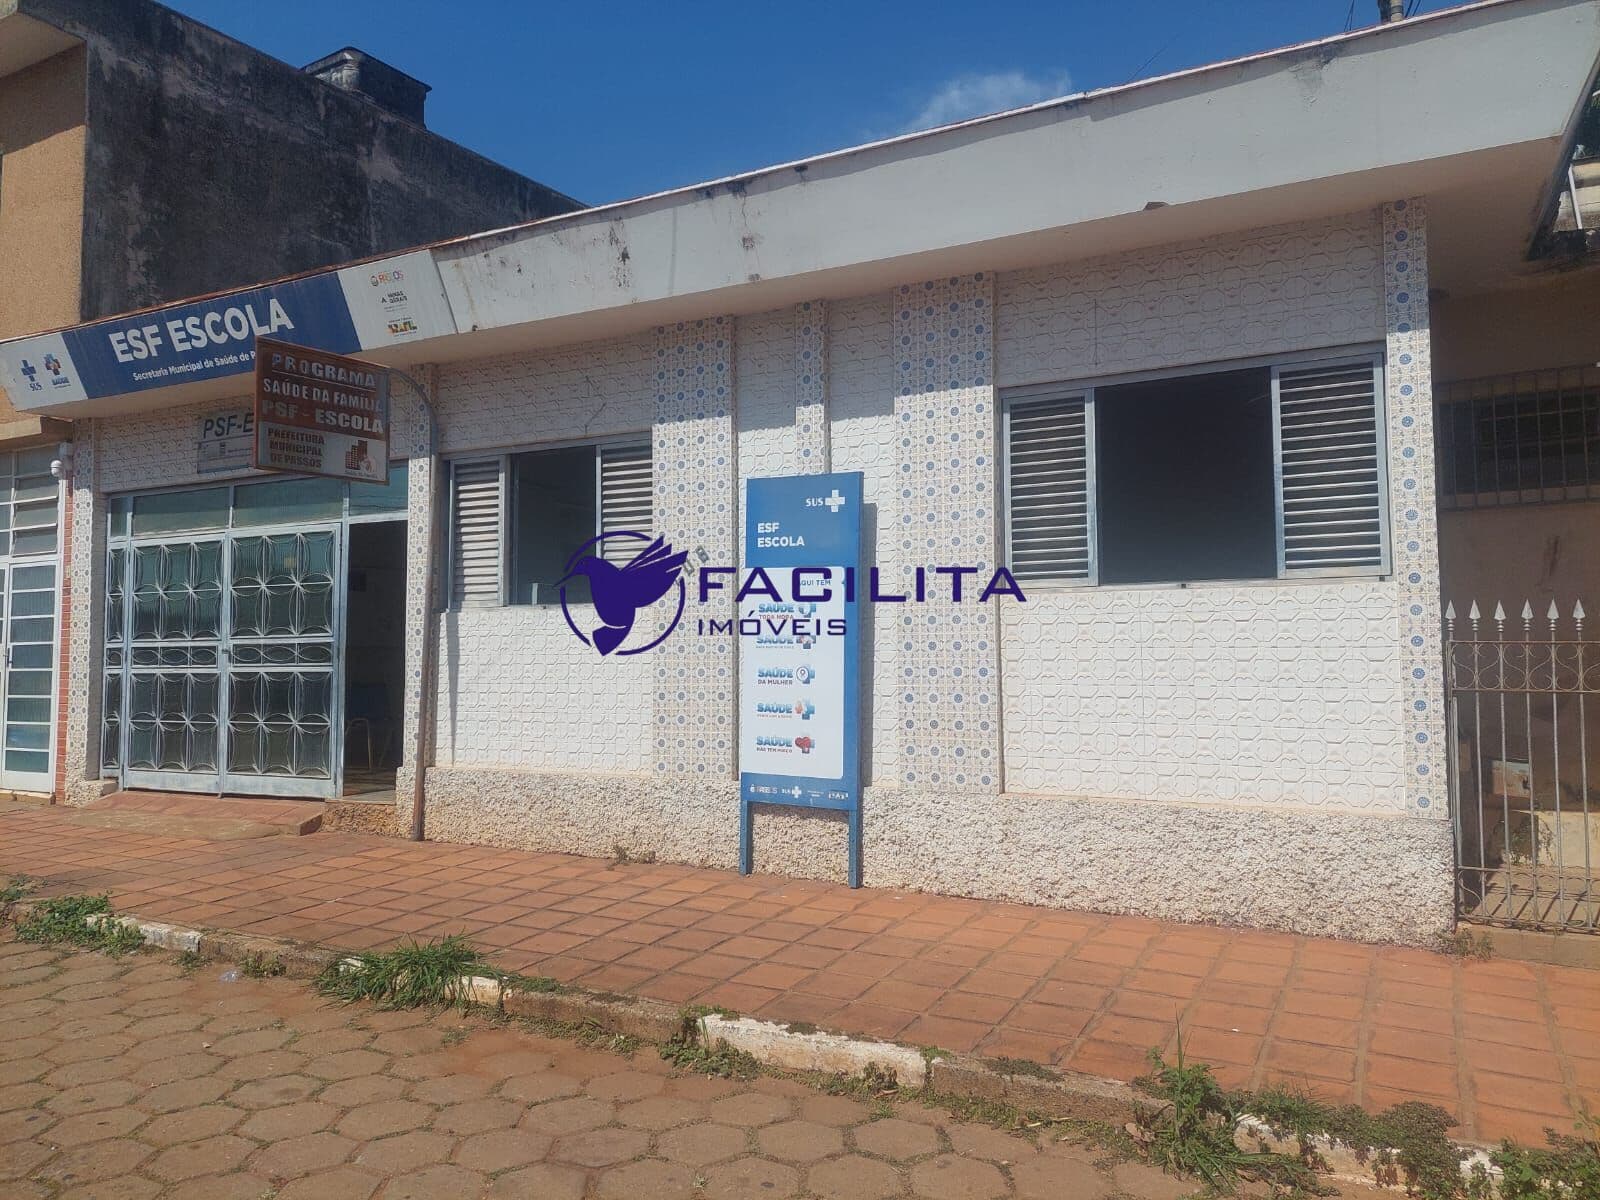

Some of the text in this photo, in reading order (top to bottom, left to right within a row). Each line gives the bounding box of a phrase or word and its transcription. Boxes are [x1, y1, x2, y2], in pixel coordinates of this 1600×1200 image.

[108, 298, 295, 363] ESF ESCOLA
[132, 367, 169, 381] Secretaria
[168, 359, 204, 376] Municipal
[204, 358, 214, 368] de
[215, 354, 239, 368] Saúde
[239, 352, 250, 362] de
[272, 353, 376, 388] PROGRAMA
[263, 378, 309, 400] SAÚDE
[312, 385, 329, 402] DA
[262, 399, 298, 419] PSF
[315, 407, 384, 434] ESCOLA
[203, 412, 255, 439] PSF-E
[268, 427, 325, 445] PREFEITURA
[269, 440, 323, 457] MUNICIPAL
[271, 452, 322, 469] DE PASSOS
[805, 497, 824, 507] SUS
[757, 522, 780, 534] ESF
[757, 535, 805, 548] ESCOLA
[757, 667, 793, 678] SAÚDE
[756, 702, 793, 714] SAÚDE
[756, 735, 793, 747] SAÚDE
